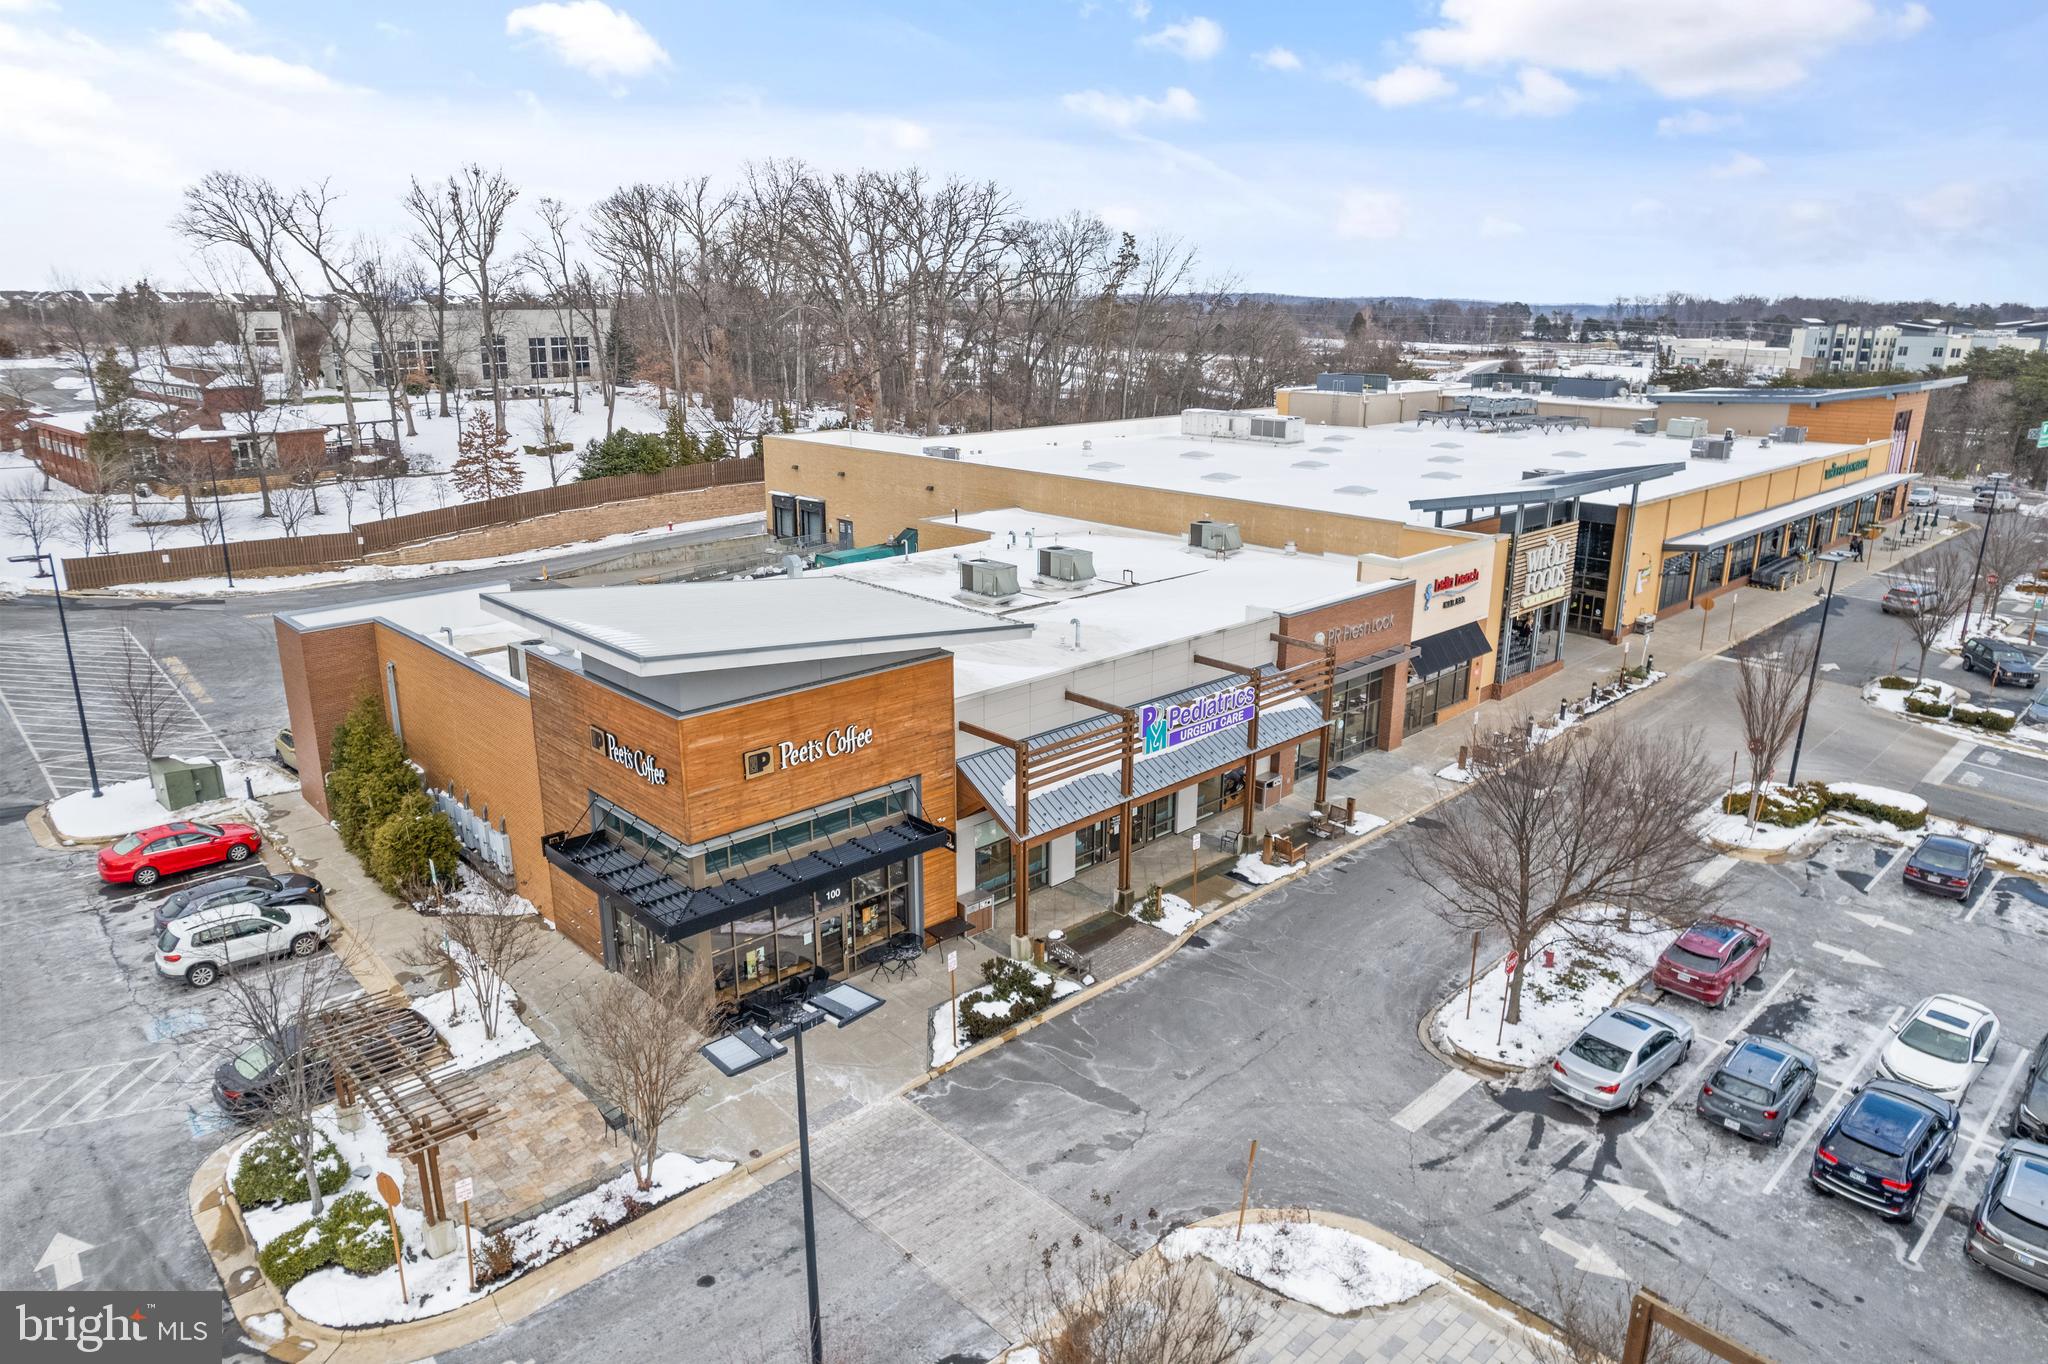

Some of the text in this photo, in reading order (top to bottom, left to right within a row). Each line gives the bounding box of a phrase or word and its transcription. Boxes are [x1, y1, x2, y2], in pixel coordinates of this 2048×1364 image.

[1525, 540, 1571, 572] WHOLE
[1523, 564, 1566, 595] FOODS
[1168, 687, 1255, 730] Pediatrics
[1180, 710, 1244, 741] URGENT CARE
[778, 724, 873, 770] Peet's Coffee
[634, 750, 666, 785] Coffee
[825, 888, 841, 900] 100
